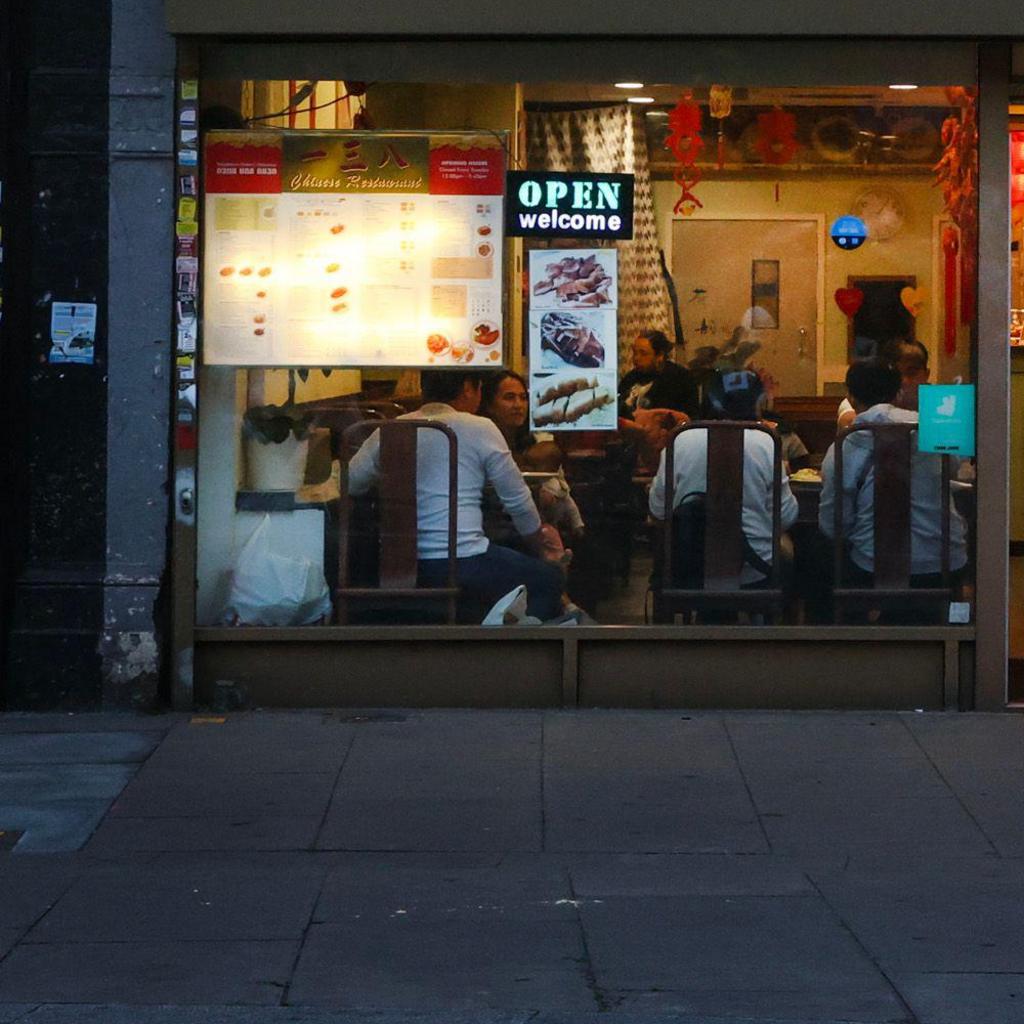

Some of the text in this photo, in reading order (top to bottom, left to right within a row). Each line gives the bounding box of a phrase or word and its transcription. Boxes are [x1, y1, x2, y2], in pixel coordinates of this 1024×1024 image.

[290, 173, 341, 190] Chinese
[518, 180, 621, 209] OPEN
[518, 209, 621, 231] welcome
